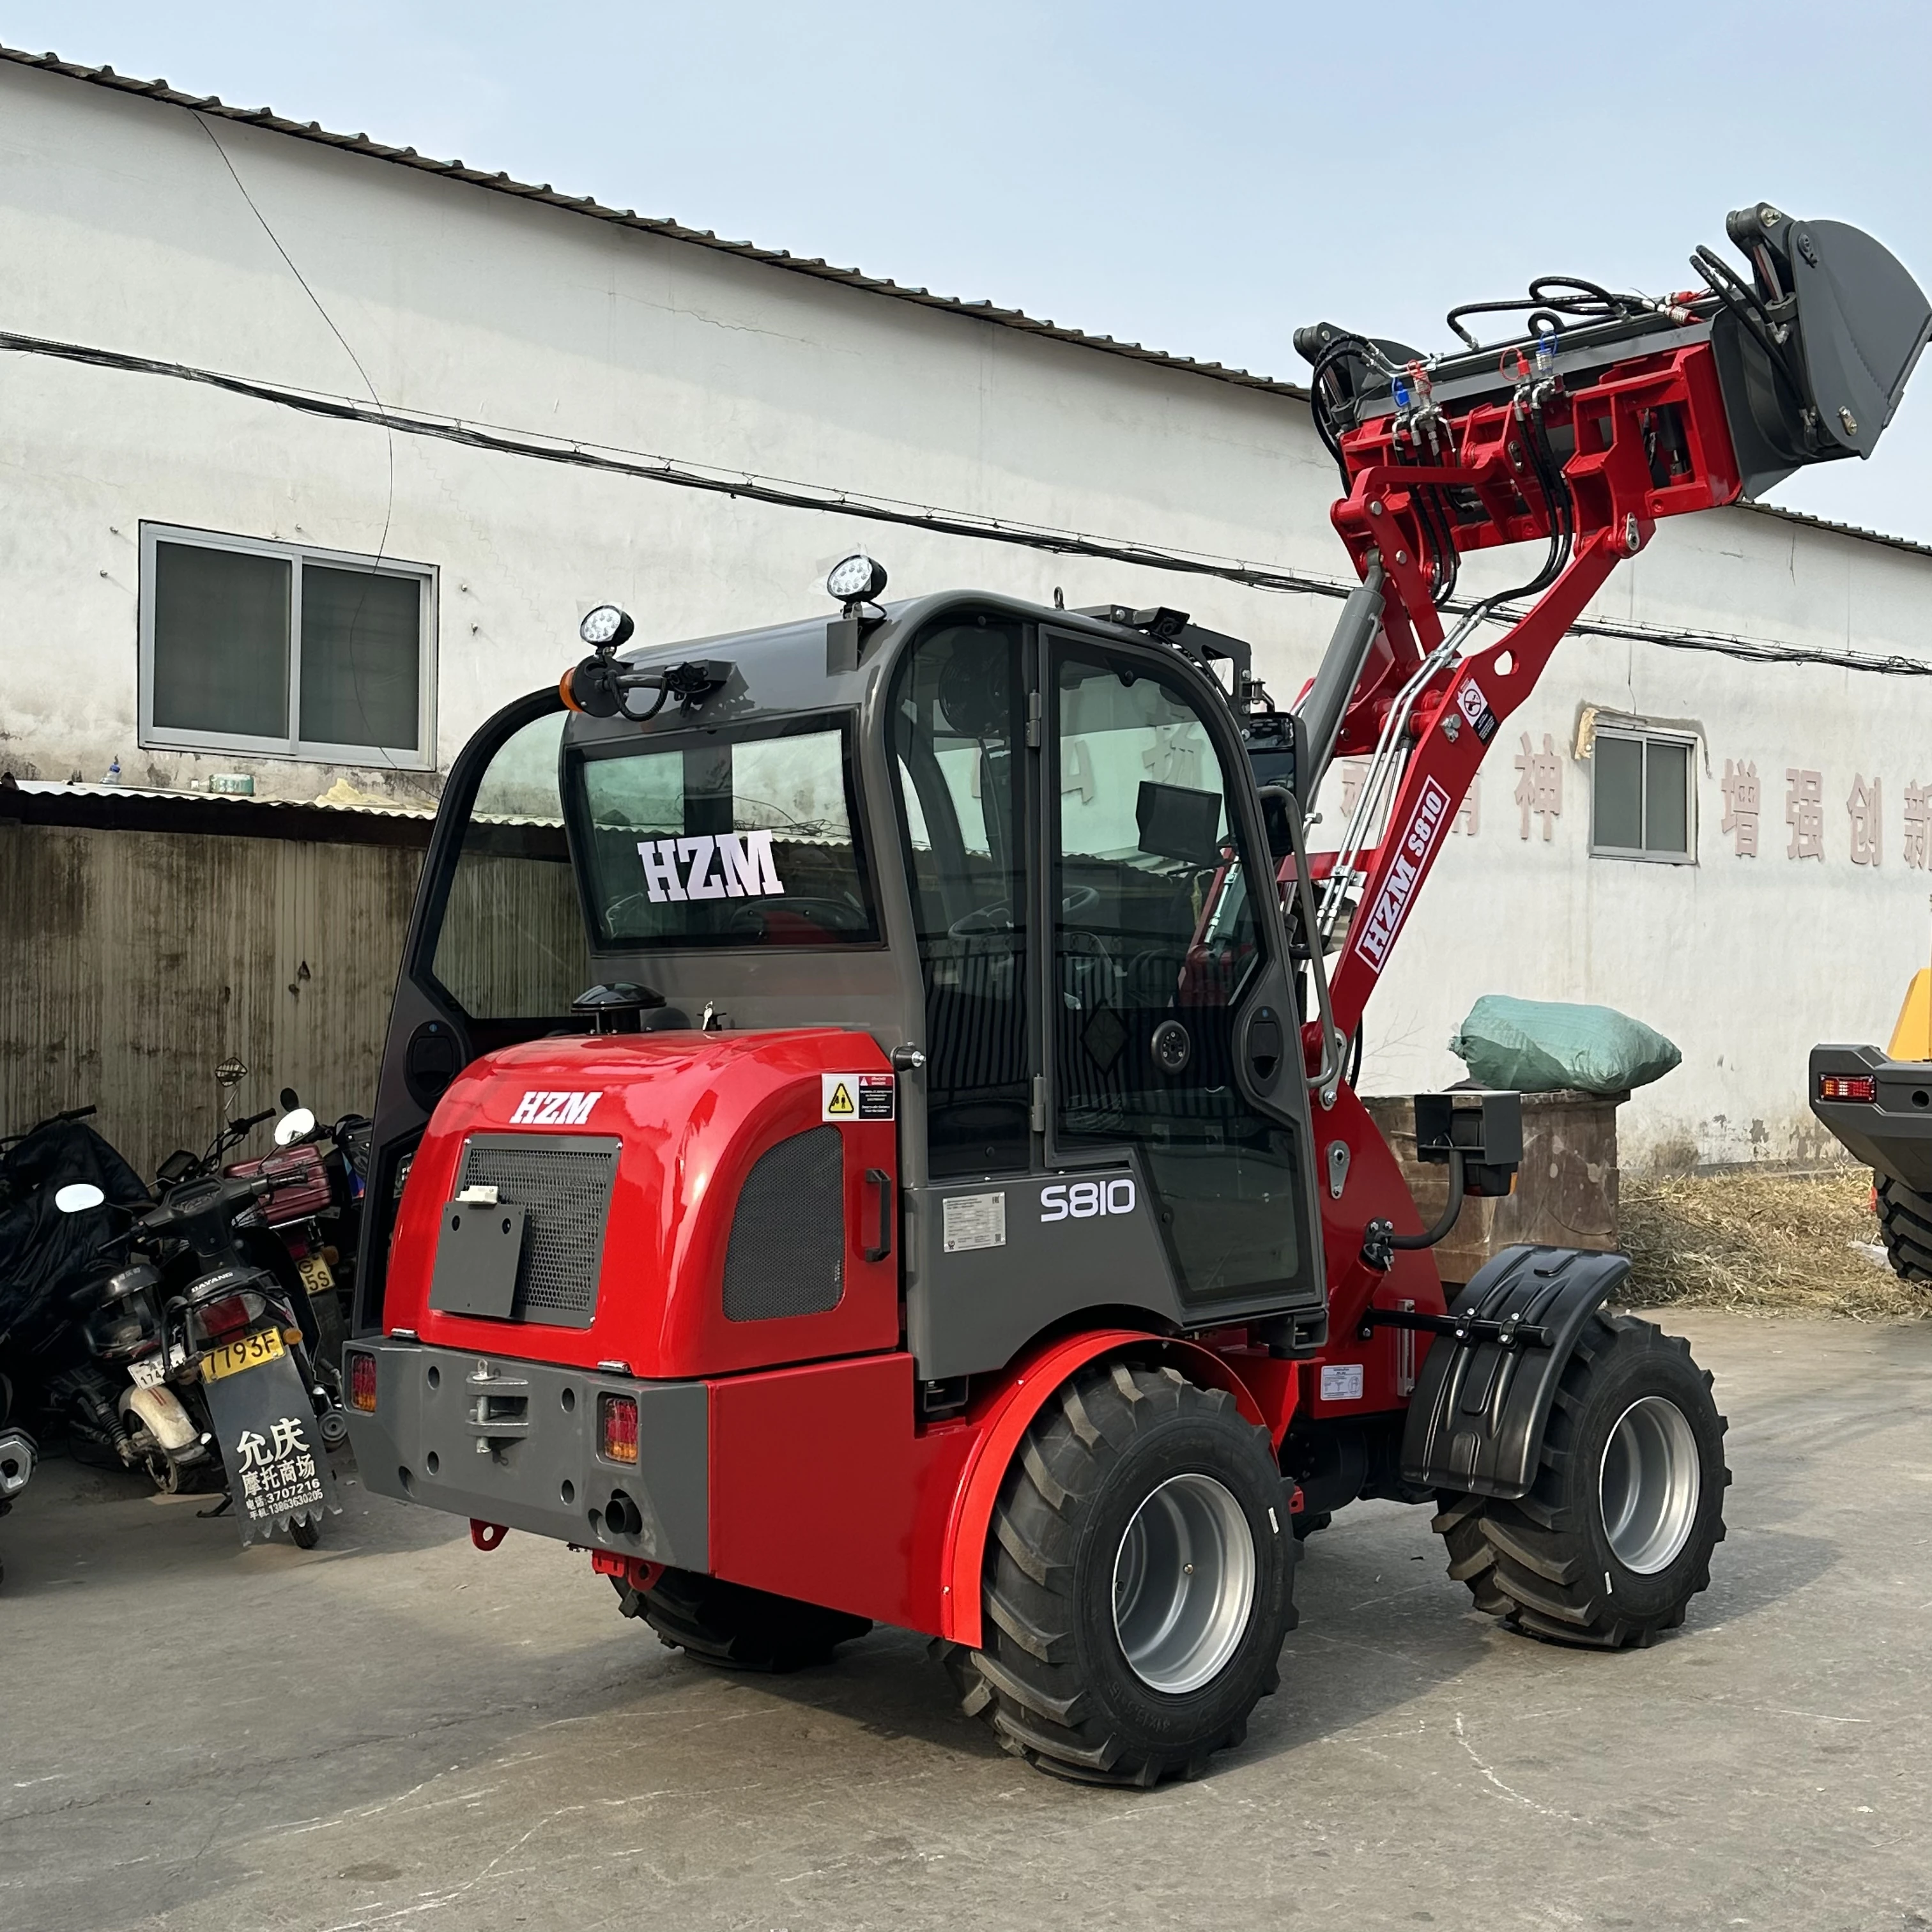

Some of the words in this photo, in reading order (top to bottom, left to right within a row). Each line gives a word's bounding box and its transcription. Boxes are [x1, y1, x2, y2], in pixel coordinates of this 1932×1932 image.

[637, 829, 785, 902] HZM
[1363, 854, 1416, 960] HZM
[1407, 791, 1442, 857] S810
[509, 1091, 603, 1124] HZM
[1041, 1179, 1135, 1222] S810
[204, 1330, 275, 1374] 7793F
[236, 1418, 310, 1473] 允庆
[241, 1453, 316, 1498] 摩托商场
